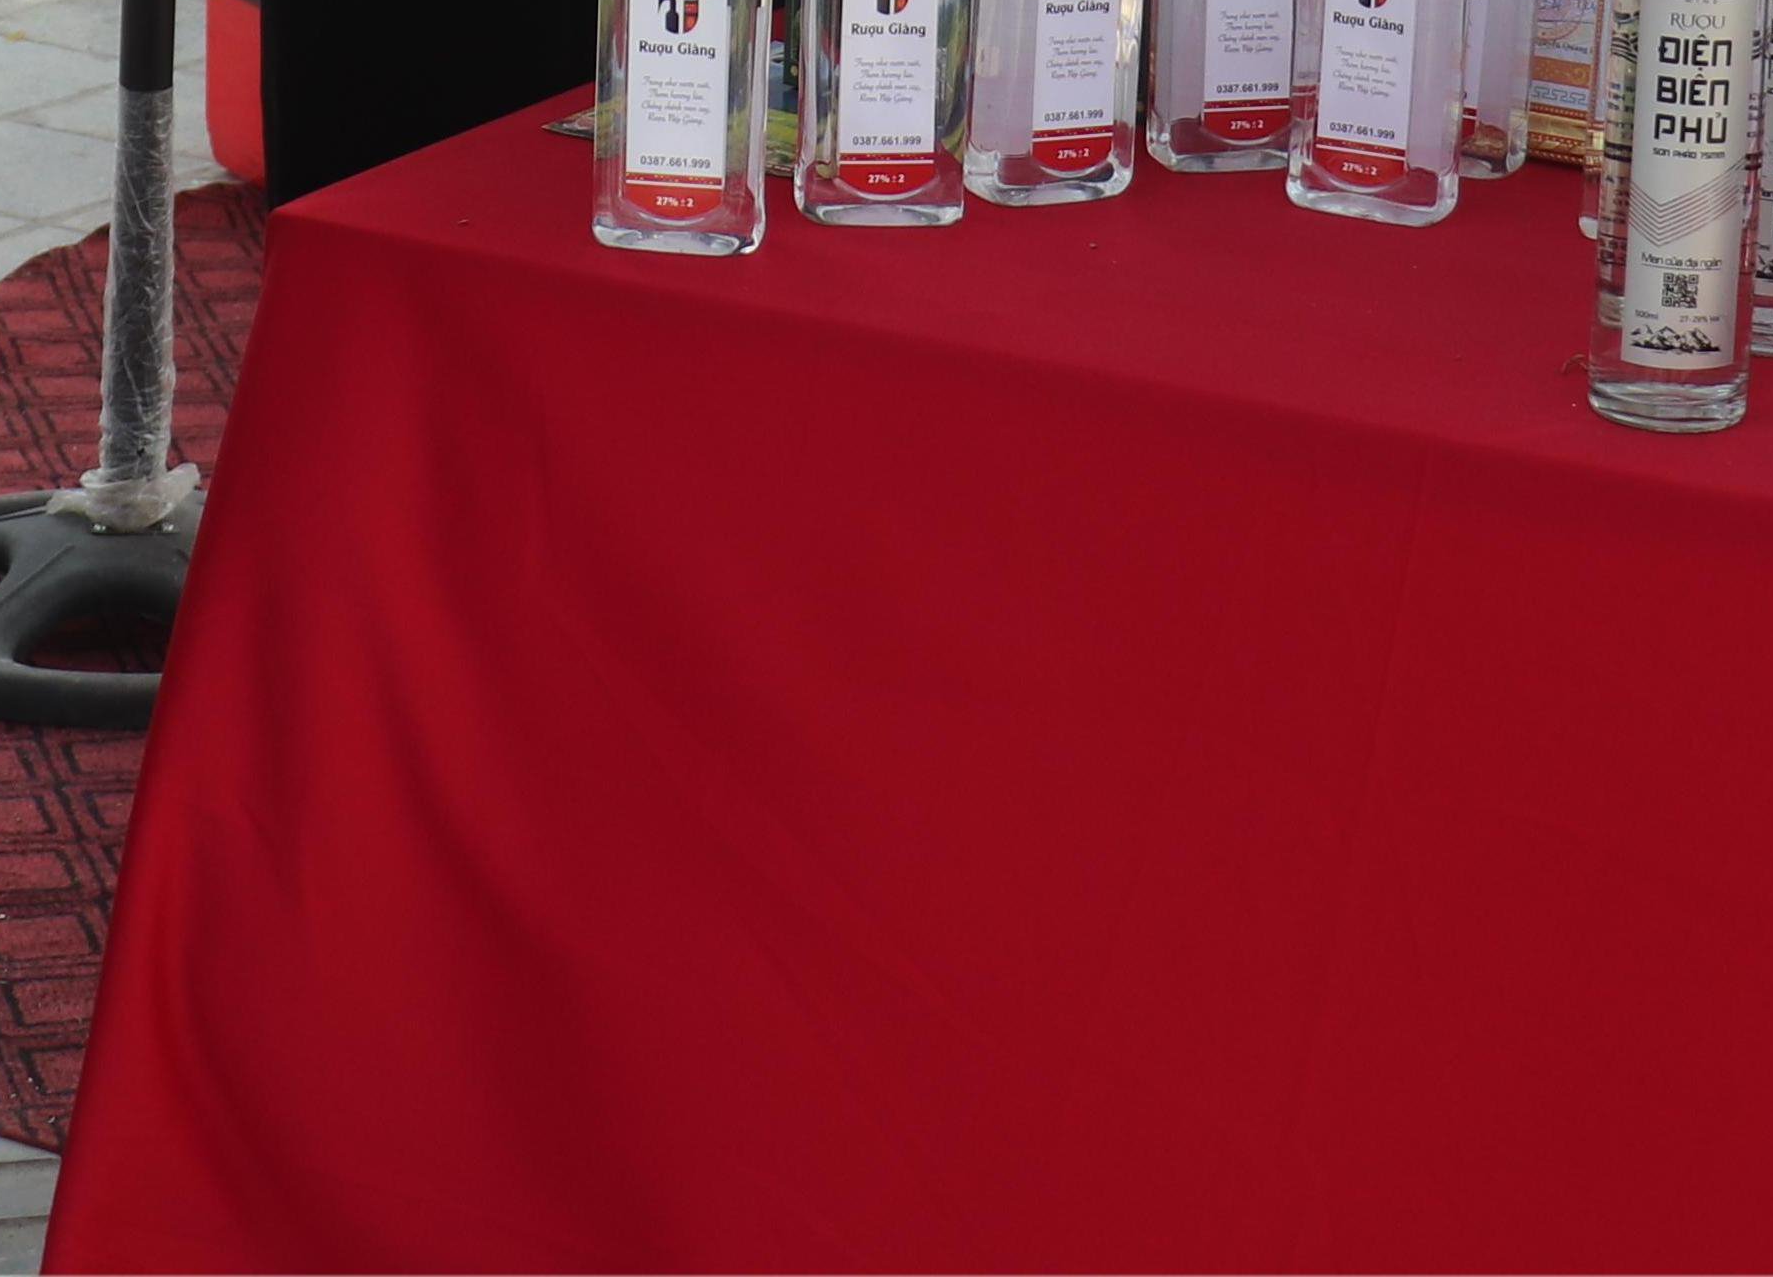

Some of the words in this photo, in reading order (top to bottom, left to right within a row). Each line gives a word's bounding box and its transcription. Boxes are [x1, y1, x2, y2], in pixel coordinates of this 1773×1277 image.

[1077, 0, 1110, 14] Giàng
[888, 22, 926, 38] Giàng
[1368, 16, 1404, 34] Giàng
[677, 41, 716, 59] Giàng
